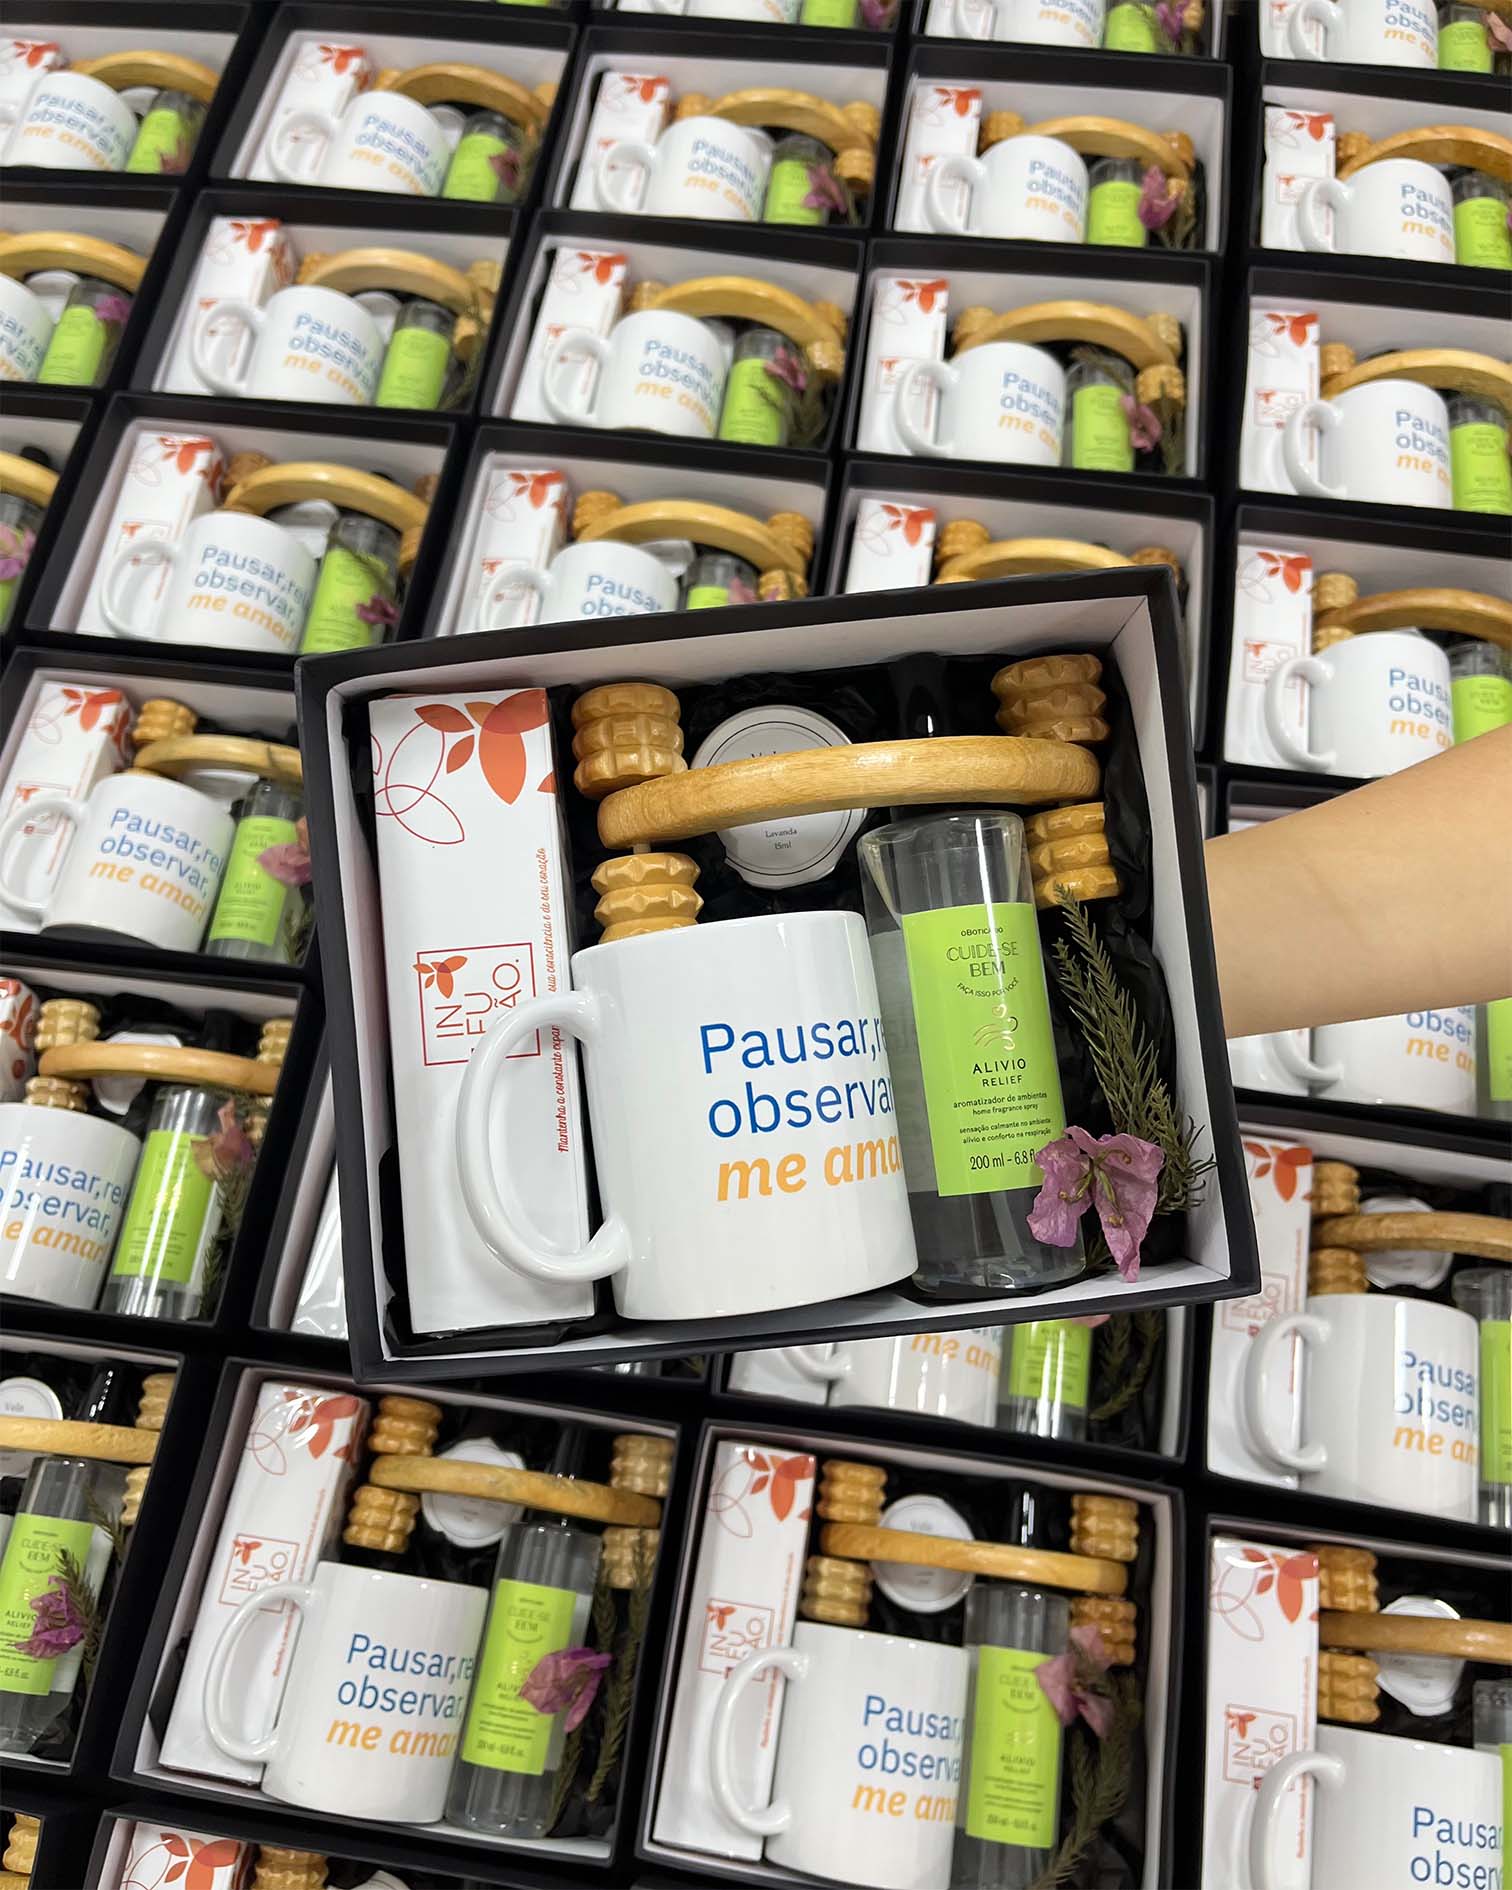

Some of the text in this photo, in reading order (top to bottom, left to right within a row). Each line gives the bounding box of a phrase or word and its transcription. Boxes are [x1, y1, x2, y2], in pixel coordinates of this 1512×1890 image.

[1384, 28, 1416, 44] me
[1402, 220, 1437, 238] me
[636, 381, 673, 399] me
[998, 413, 1035, 433] me
[1397, 454, 1433, 474] me
[187, 593, 226, 612] me
[1390, 719, 1430, 738] me
[89, 860, 134, 884] me
[969, 960, 1006, 978] BEM
[551, 1024, 565, 1049] expan
[1405, 1037, 1449, 1062] me
[972, 1058, 1027, 1075] ALIVIO
[982, 1074, 1023, 1087] RELIEF
[953, 1096, 1006, 1109] aromatizador
[1006, 1094, 1016, 1103] de
[972, 1102, 1039, 1115] home fragrance spray
[990, 1121, 1020, 1131] calmante
[987, 1133, 1015, 1142] conforto
[717, 1135, 902, 1202] me ama
[969, 1154, 990, 1170] 200
[992, 1151, 1005, 1168] ml
[1014, 1150, 1029, 1166] 6.8
[911, 1333, 960, 1360] me
[1393, 1425, 1445, 1455] me
[326, 1717, 383, 1751] me
[851, 1783, 907, 1817] me
